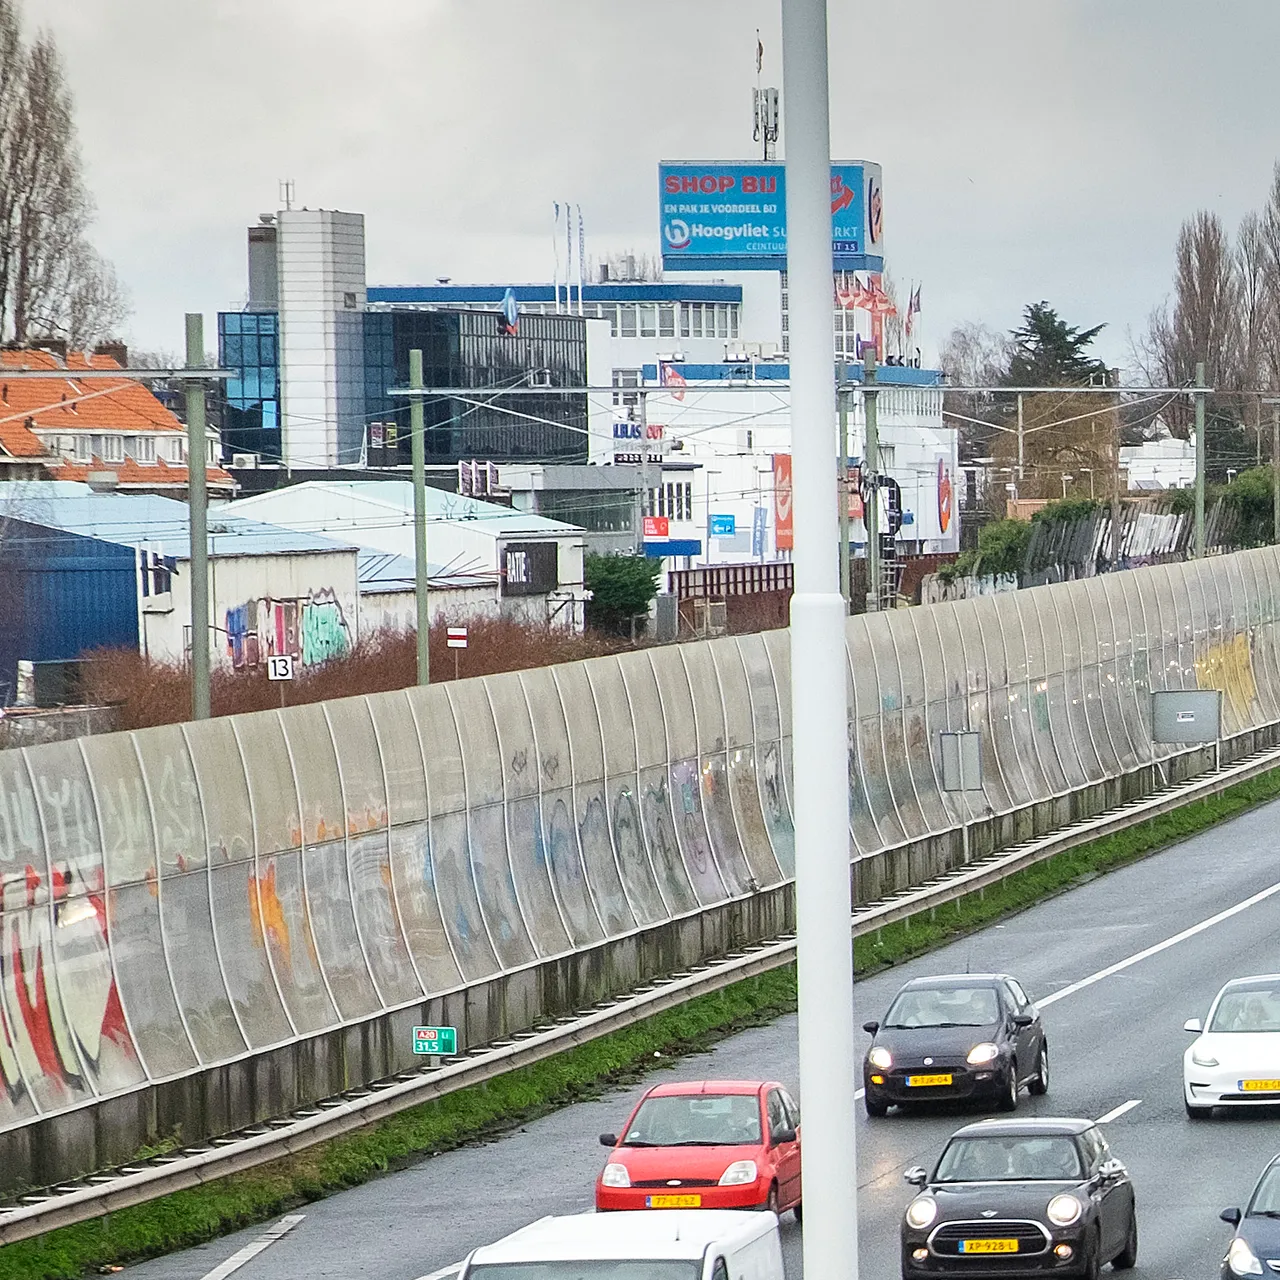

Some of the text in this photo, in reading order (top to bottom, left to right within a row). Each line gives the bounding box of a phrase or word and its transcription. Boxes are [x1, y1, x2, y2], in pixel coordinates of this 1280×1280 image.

[665, 175, 735, 194] SHOP
[664, 204, 678, 213] EN
[679, 204, 698, 213] PAK
[711, 204, 760, 213] VOORDEEL
[691, 223, 769, 240] Hoogvliet
[271, 658, 289, 677] 13
[419, 1030, 435, 1039] A20
[416, 1041, 438, 1051] 31.5
